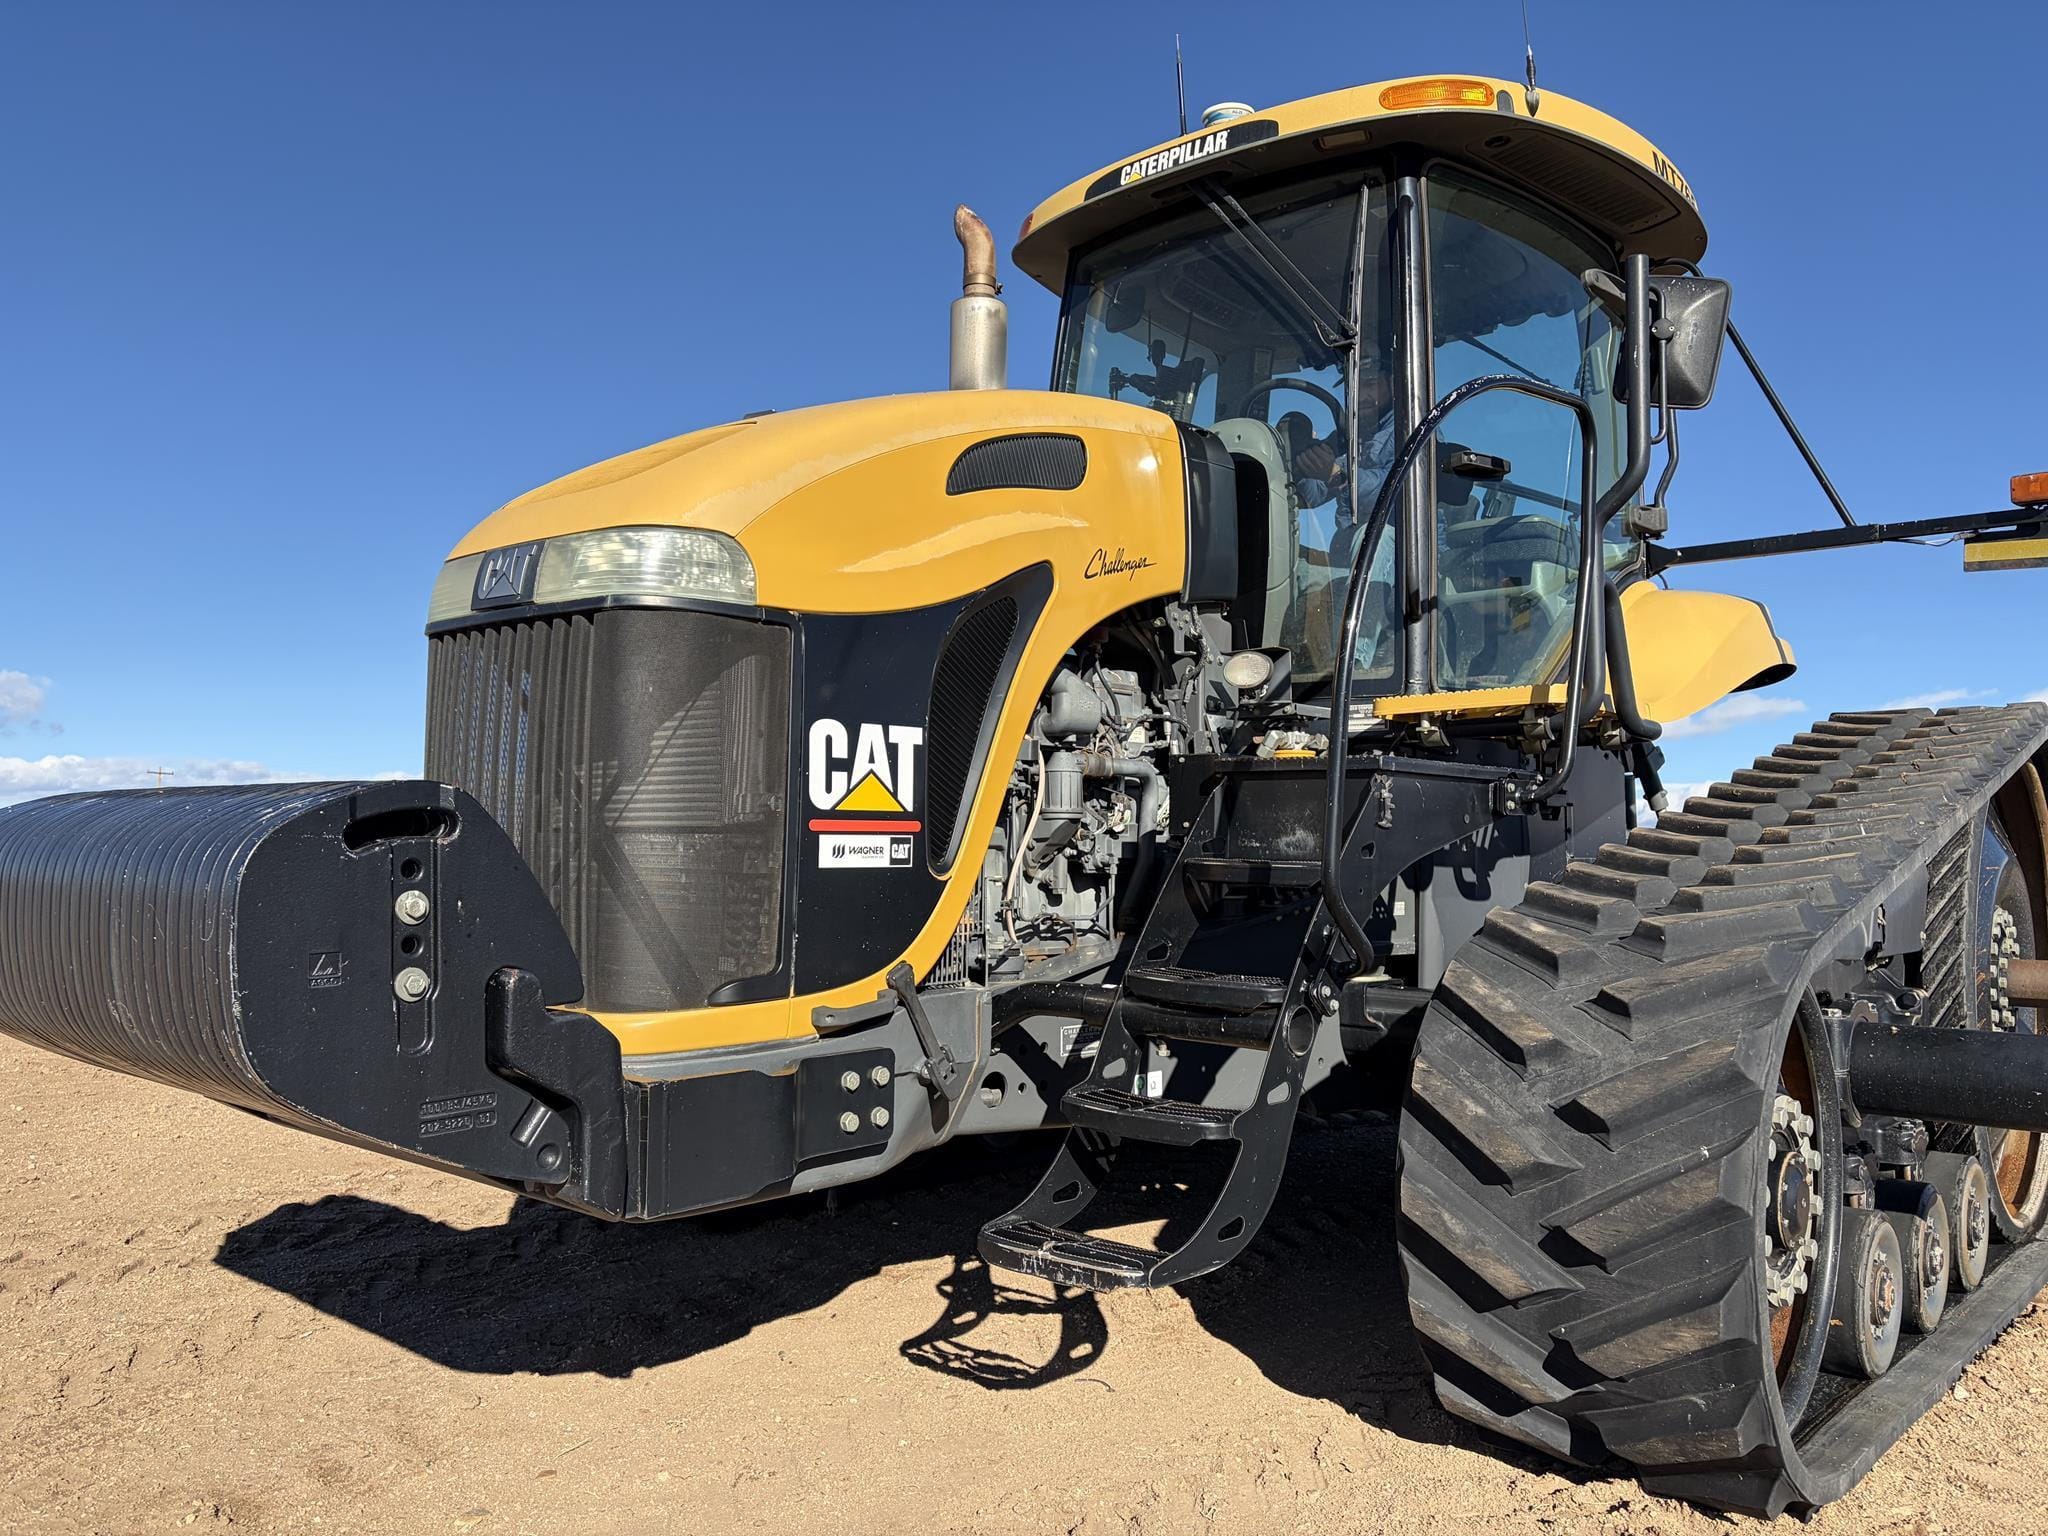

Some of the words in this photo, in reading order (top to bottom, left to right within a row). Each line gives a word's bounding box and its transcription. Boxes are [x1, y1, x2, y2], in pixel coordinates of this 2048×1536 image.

[1120, 131, 1230, 186] CATERPILLAR
[478, 545, 537, 599] CAT
[1084, 548, 1157, 581] Challenger
[809, 718, 923, 812] CAT
[849, 845, 885, 855] WAGNER
[892, 844, 910, 858] CAT
